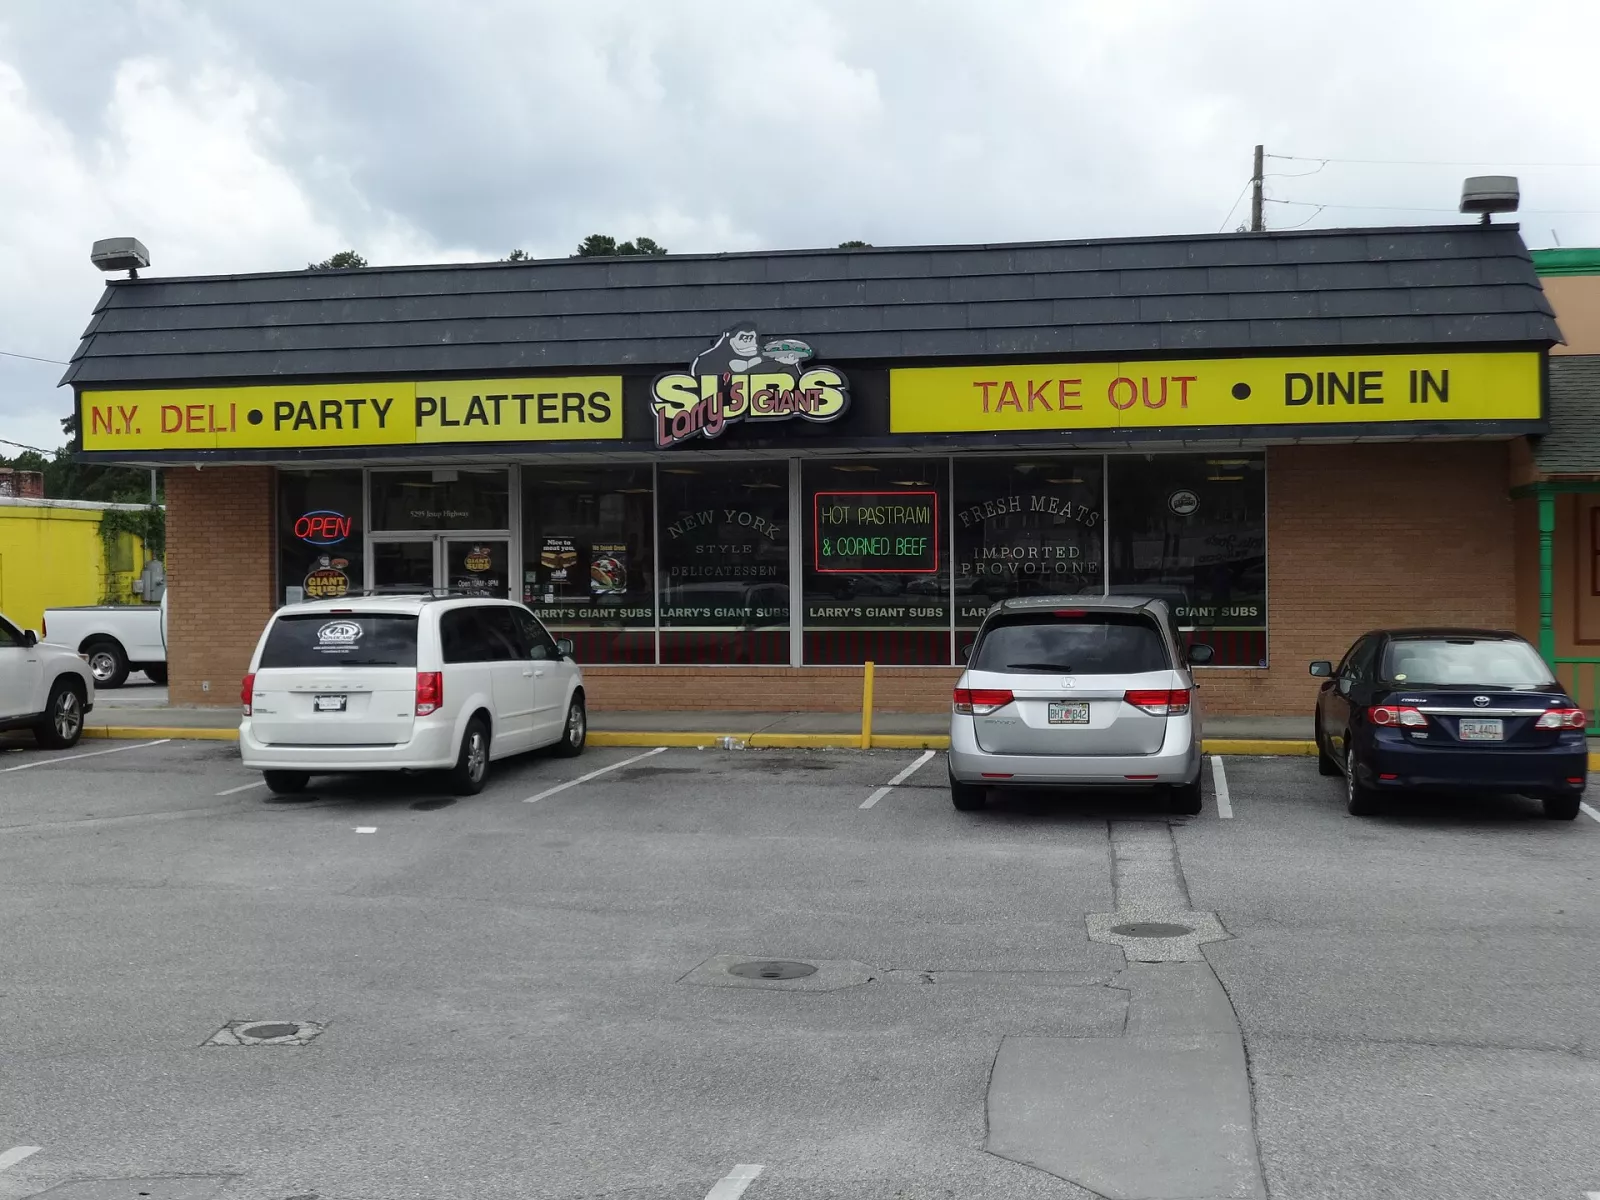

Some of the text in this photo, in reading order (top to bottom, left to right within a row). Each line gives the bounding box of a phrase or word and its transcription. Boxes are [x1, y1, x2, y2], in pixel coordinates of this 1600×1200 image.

[655, 369, 844, 420] SUBS
[973, 369, 1449, 413] TAKE OUT DINE IN
[92, 391, 611, 434] N.Y. DELI PARTY PLATTERS
[658, 371, 824, 446] Larry's GIANT
[443, 510, 469, 519] Highway
[822, 506, 930, 525] HOT PASTRAMI
[958, 495, 1100, 528] FRESH MEATS
[294, 516, 352, 538] OPEN
[667, 509, 780, 540] NEW YORK
[695, 545, 752, 554] STYLE
[822, 537, 927, 556] & CORNED BEEF
[973, 547, 1080, 559] IMPORTED
[671, 566, 777, 576] DELICATESSEN
[961, 562, 1097, 575] PROVOLONE
[308, 577, 345, 585] GIANT
[458, 580, 471, 588] Open
[307, 585, 347, 596] SUBS
[534, 608, 652, 618] ARRY'S GIANT SUBS
[660, 607, 789, 618] LARRY'S GIANT SUBS
[809, 607, 943, 618] LARRY'S GIANT SUBS
[1175, 607, 1258, 617] GIANT SUBS
